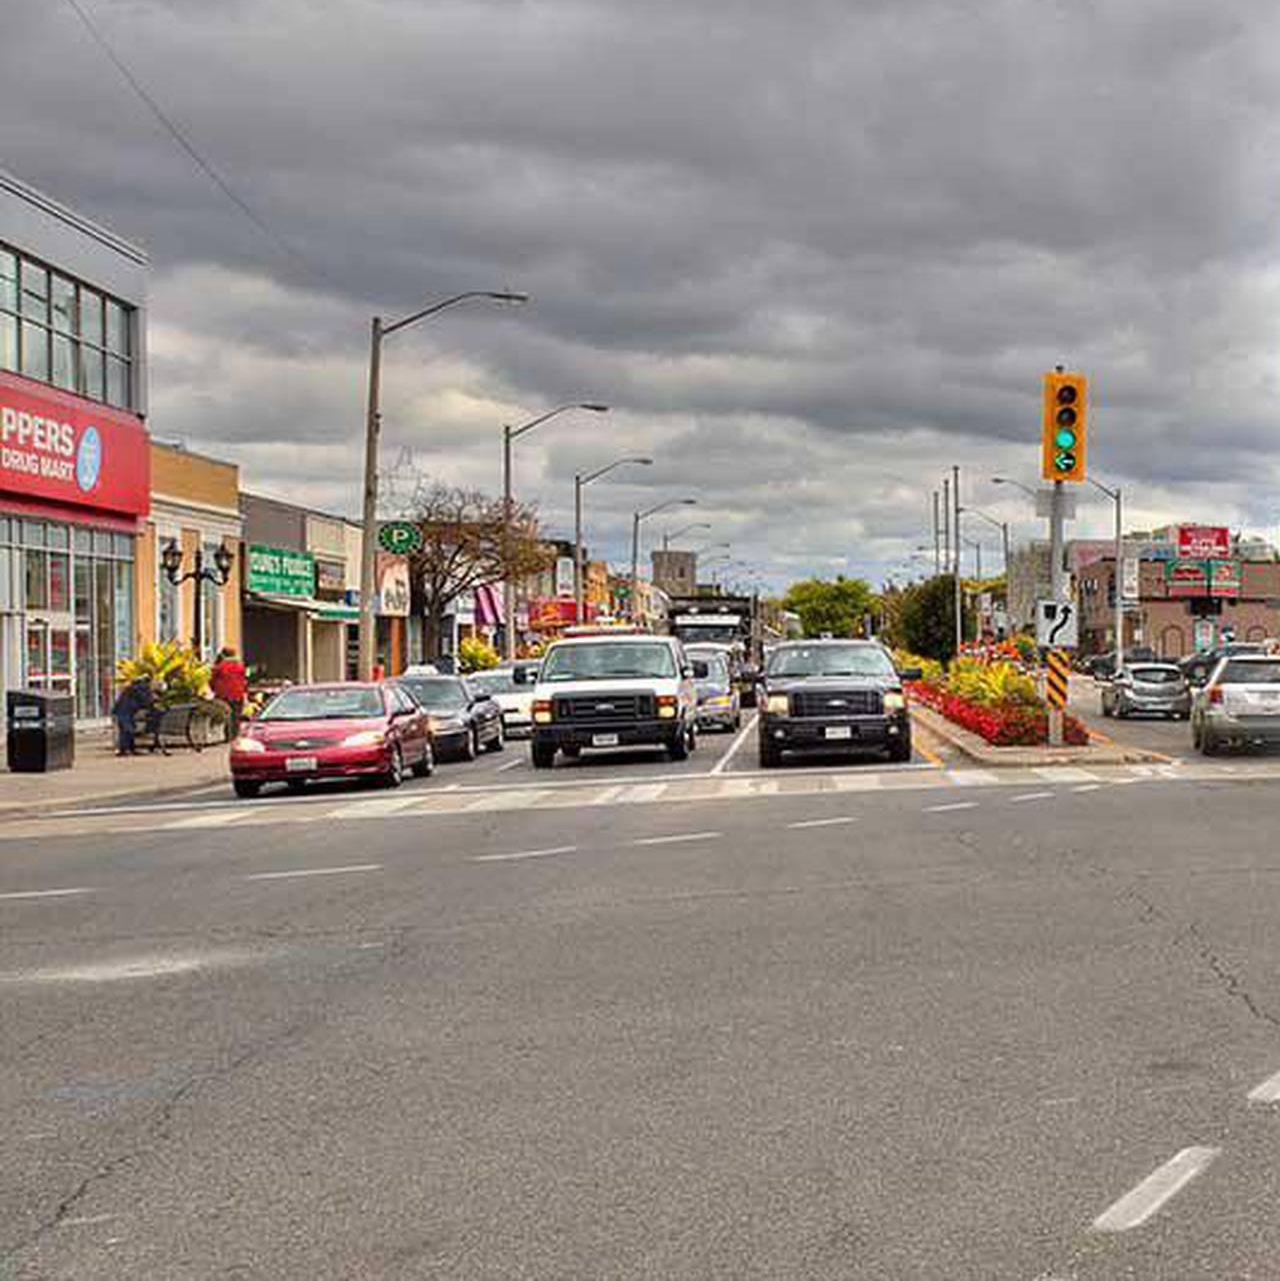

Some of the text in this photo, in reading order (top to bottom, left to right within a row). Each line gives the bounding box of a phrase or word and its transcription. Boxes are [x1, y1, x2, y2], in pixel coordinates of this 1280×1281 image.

[1, 407, 75, 457] PPERS
[0, 448, 75, 482] DRUG MART
[392, 529, 409, 544] P
